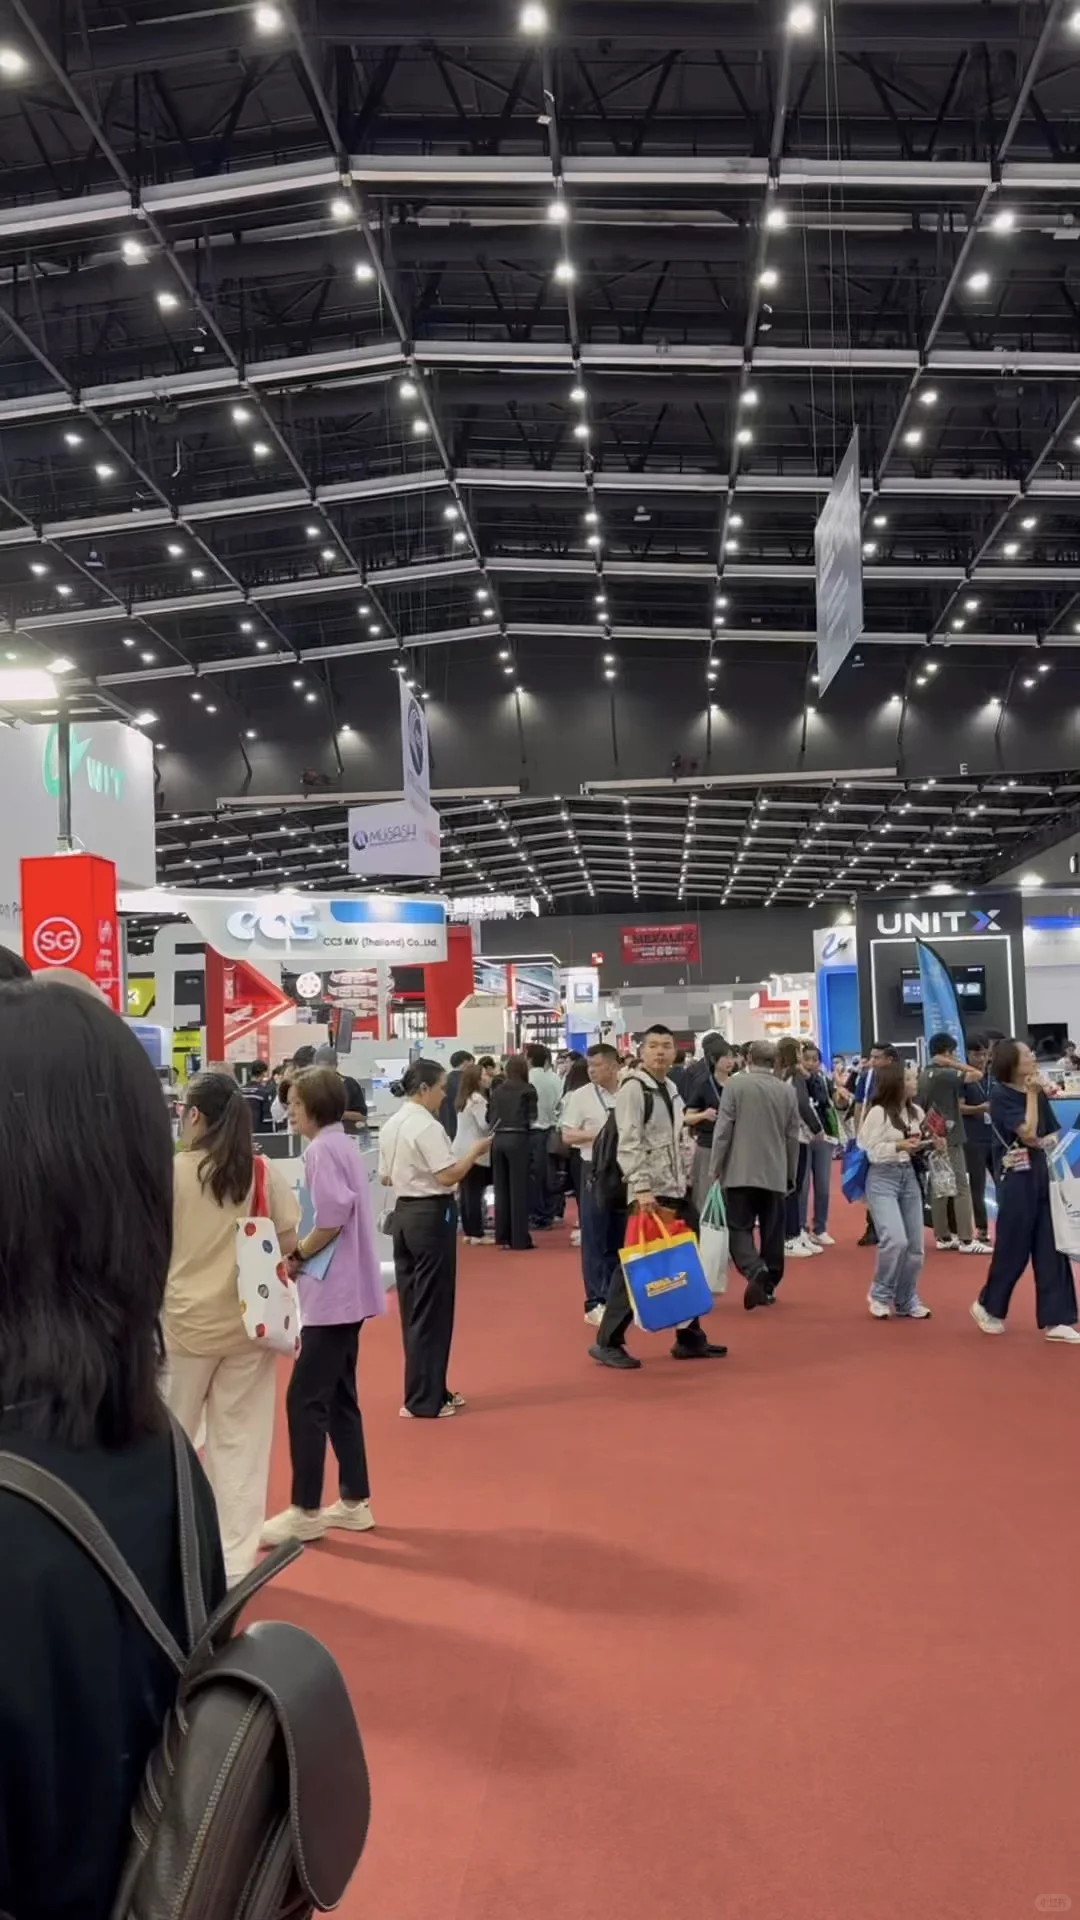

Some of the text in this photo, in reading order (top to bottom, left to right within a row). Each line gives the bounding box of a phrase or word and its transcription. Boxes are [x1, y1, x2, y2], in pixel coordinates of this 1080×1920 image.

[876, 909, 1001, 935] UNITX
[40, 930, 75, 951] SG
[323, 938, 343, 947] CCS
